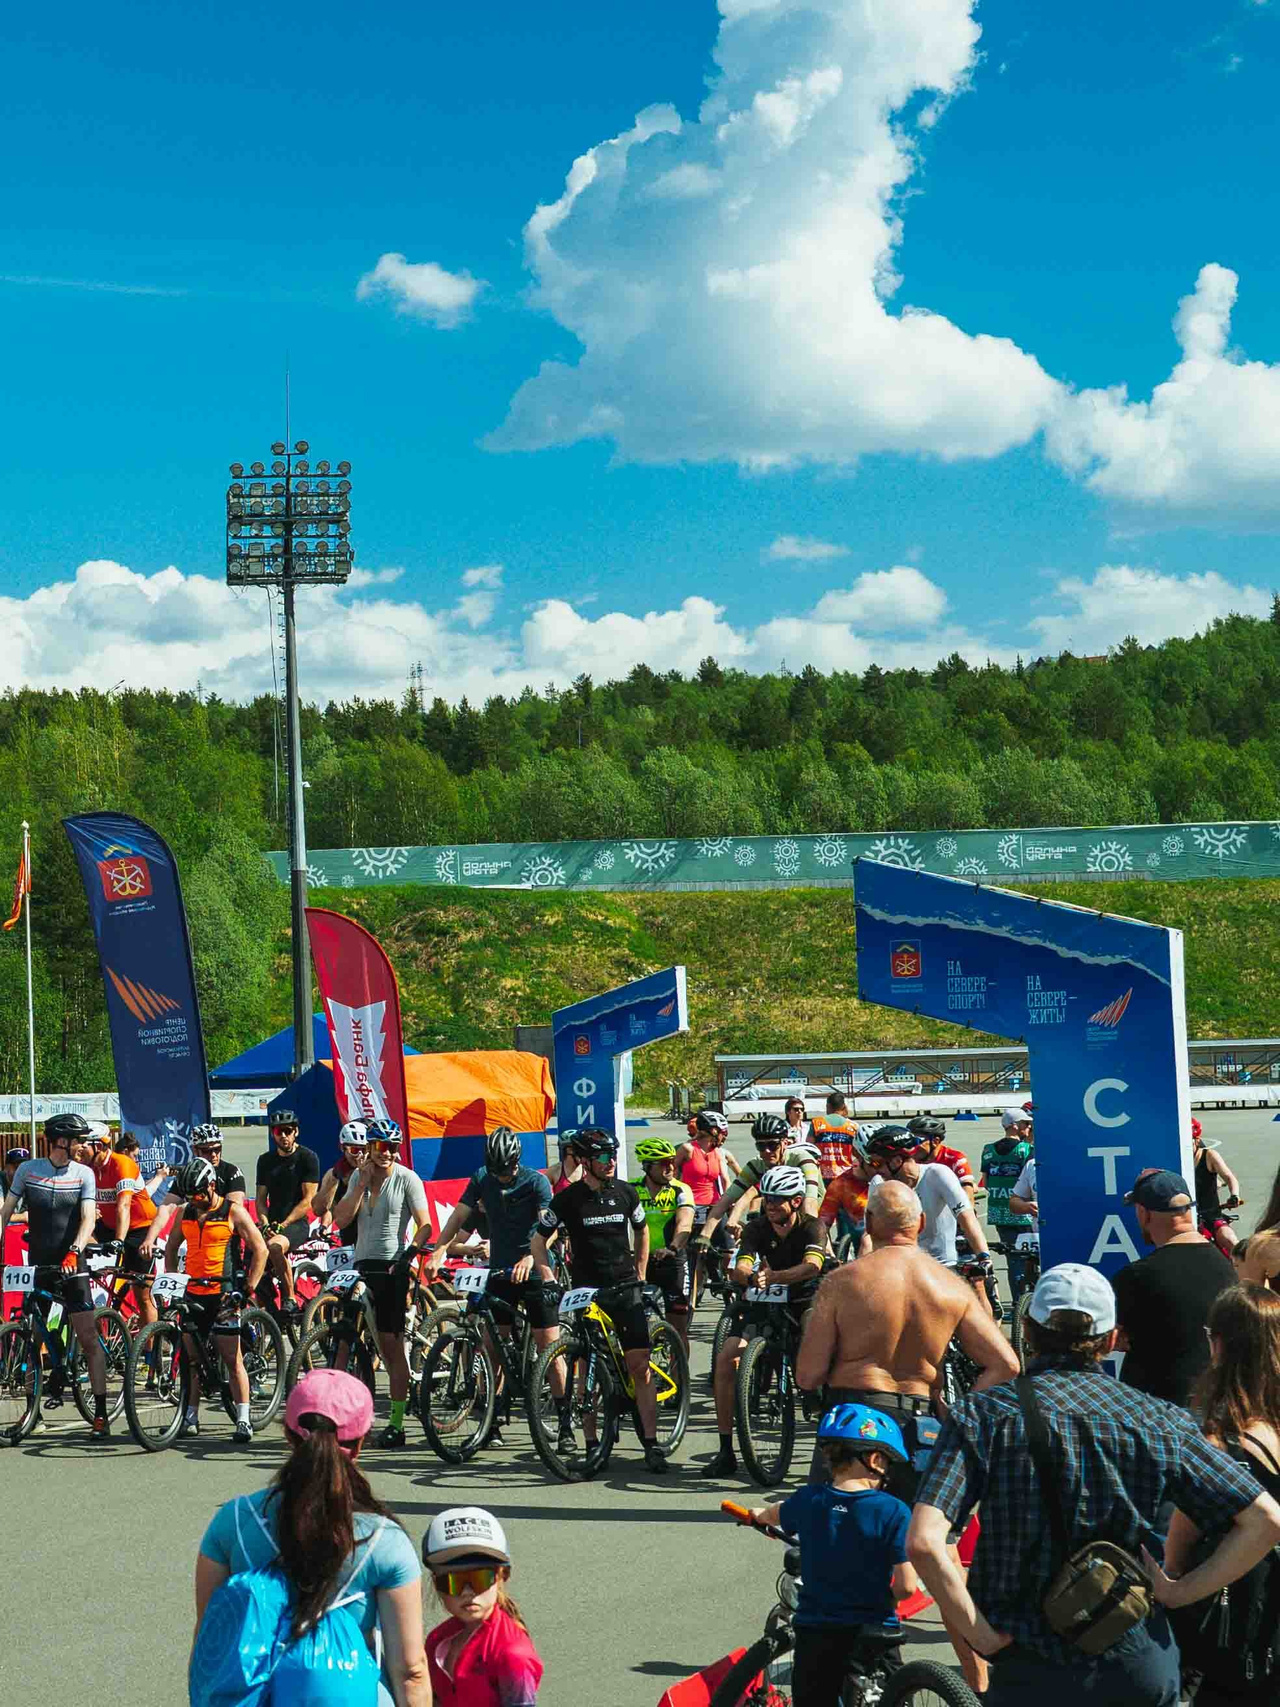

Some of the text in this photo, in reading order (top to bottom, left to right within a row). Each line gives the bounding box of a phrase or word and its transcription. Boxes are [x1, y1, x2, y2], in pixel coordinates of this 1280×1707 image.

[947, 960, 962, 976] НА
[1026, 975, 1042, 991] НА
[947, 993, 986, 1010] СПОРТ!
[1028, 1008, 1066, 1025] ЖИТЬ!
[573, 1077, 597, 1125] ФИ
[1021, 1241, 1039, 1251] 85
[331, 1253, 349, 1266] 78
[5, 1272, 31, 1286] 110
[159, 1279, 178, 1291] 93
[331, 1274, 356, 1283] 130
[456, 1275, 482, 1288] 111
[564, 1291, 591, 1307] 125
